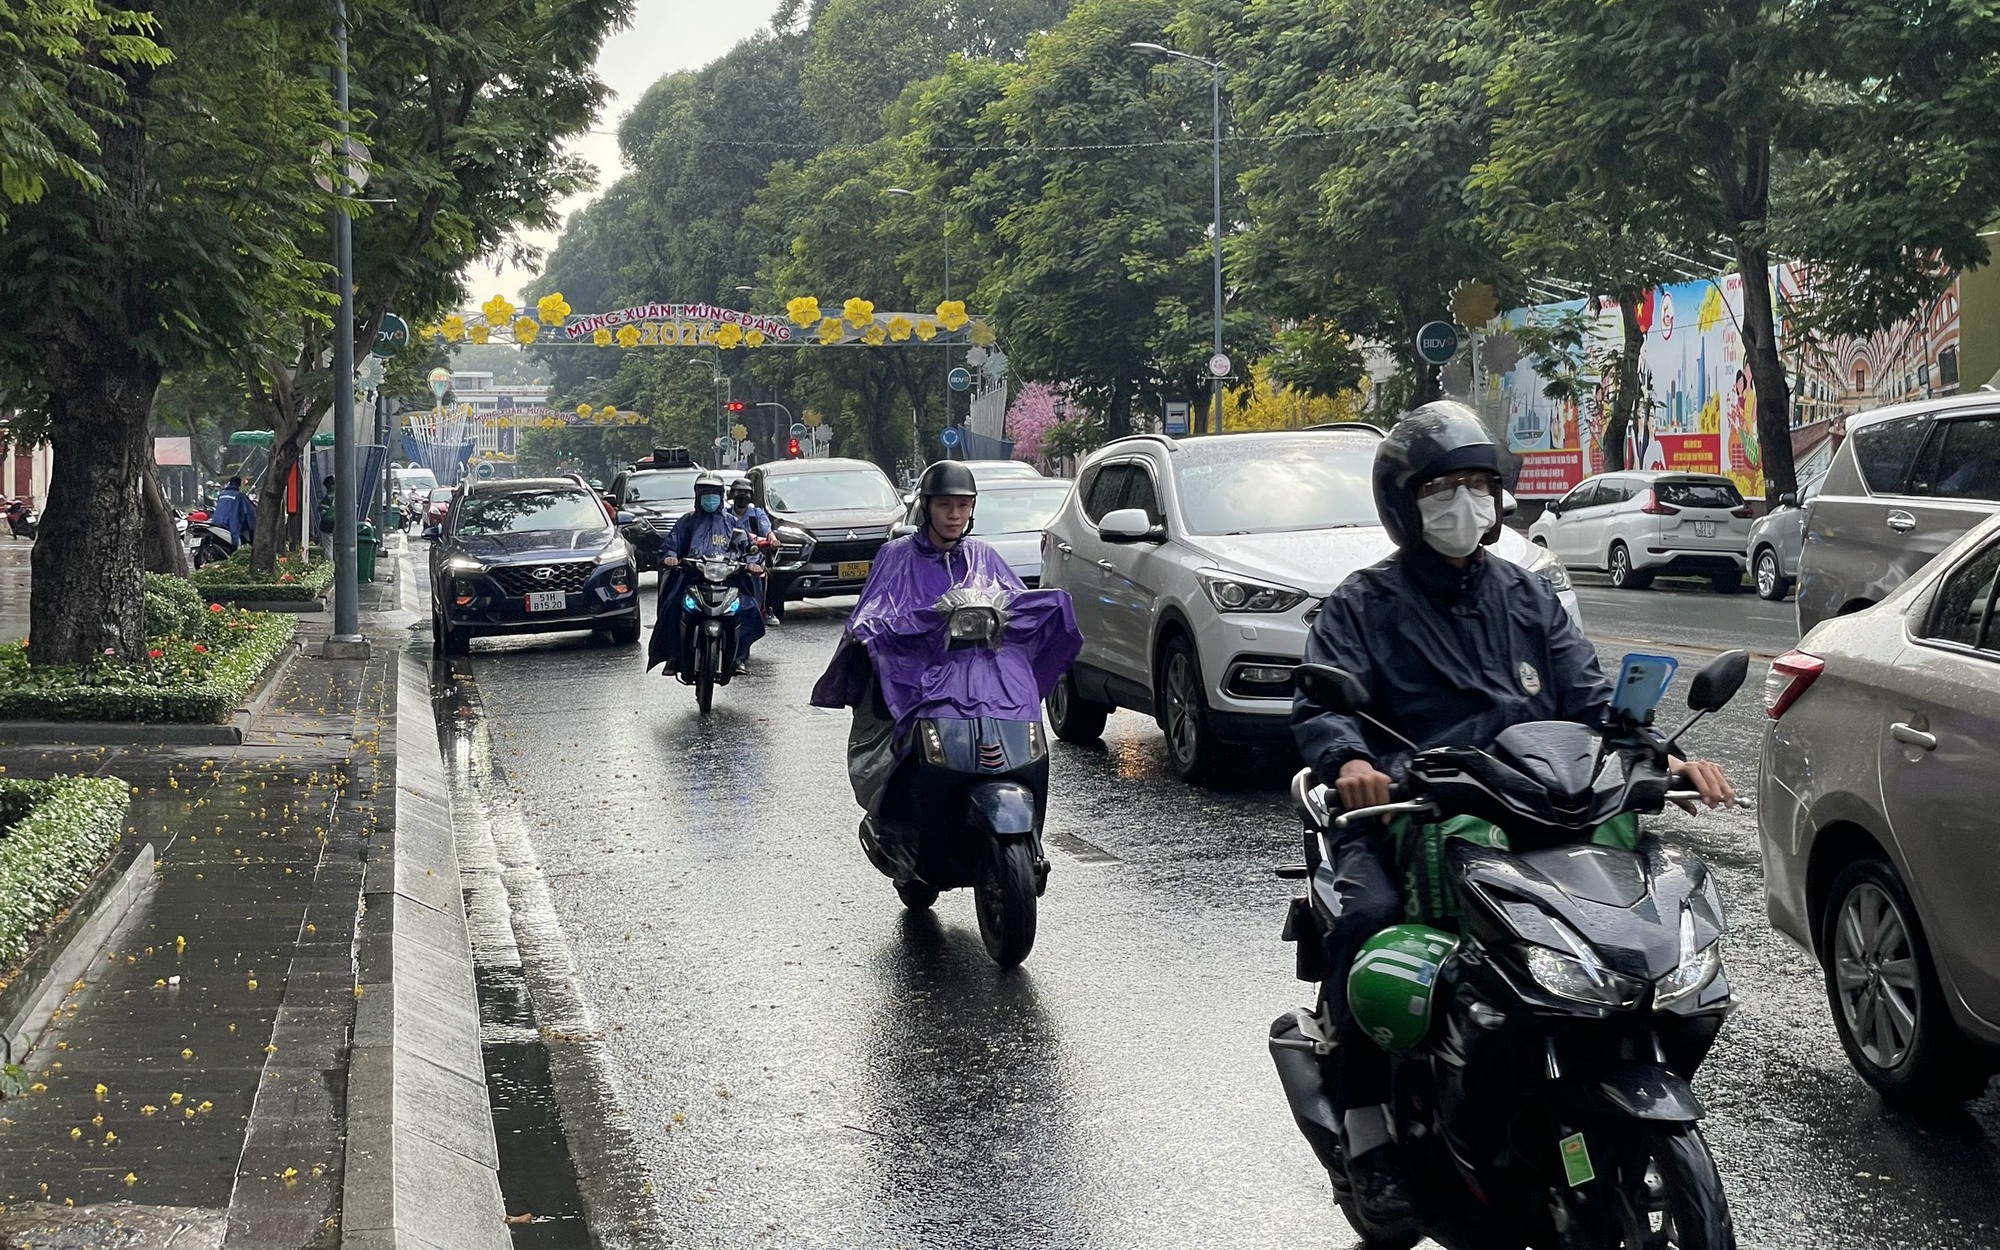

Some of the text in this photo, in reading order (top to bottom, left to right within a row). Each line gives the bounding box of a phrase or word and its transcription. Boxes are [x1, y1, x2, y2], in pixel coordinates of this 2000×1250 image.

[642, 321, 717, 346] 2024
[1423, 338, 1446, 348] BIDV
[540, 593, 555, 601] 51H
